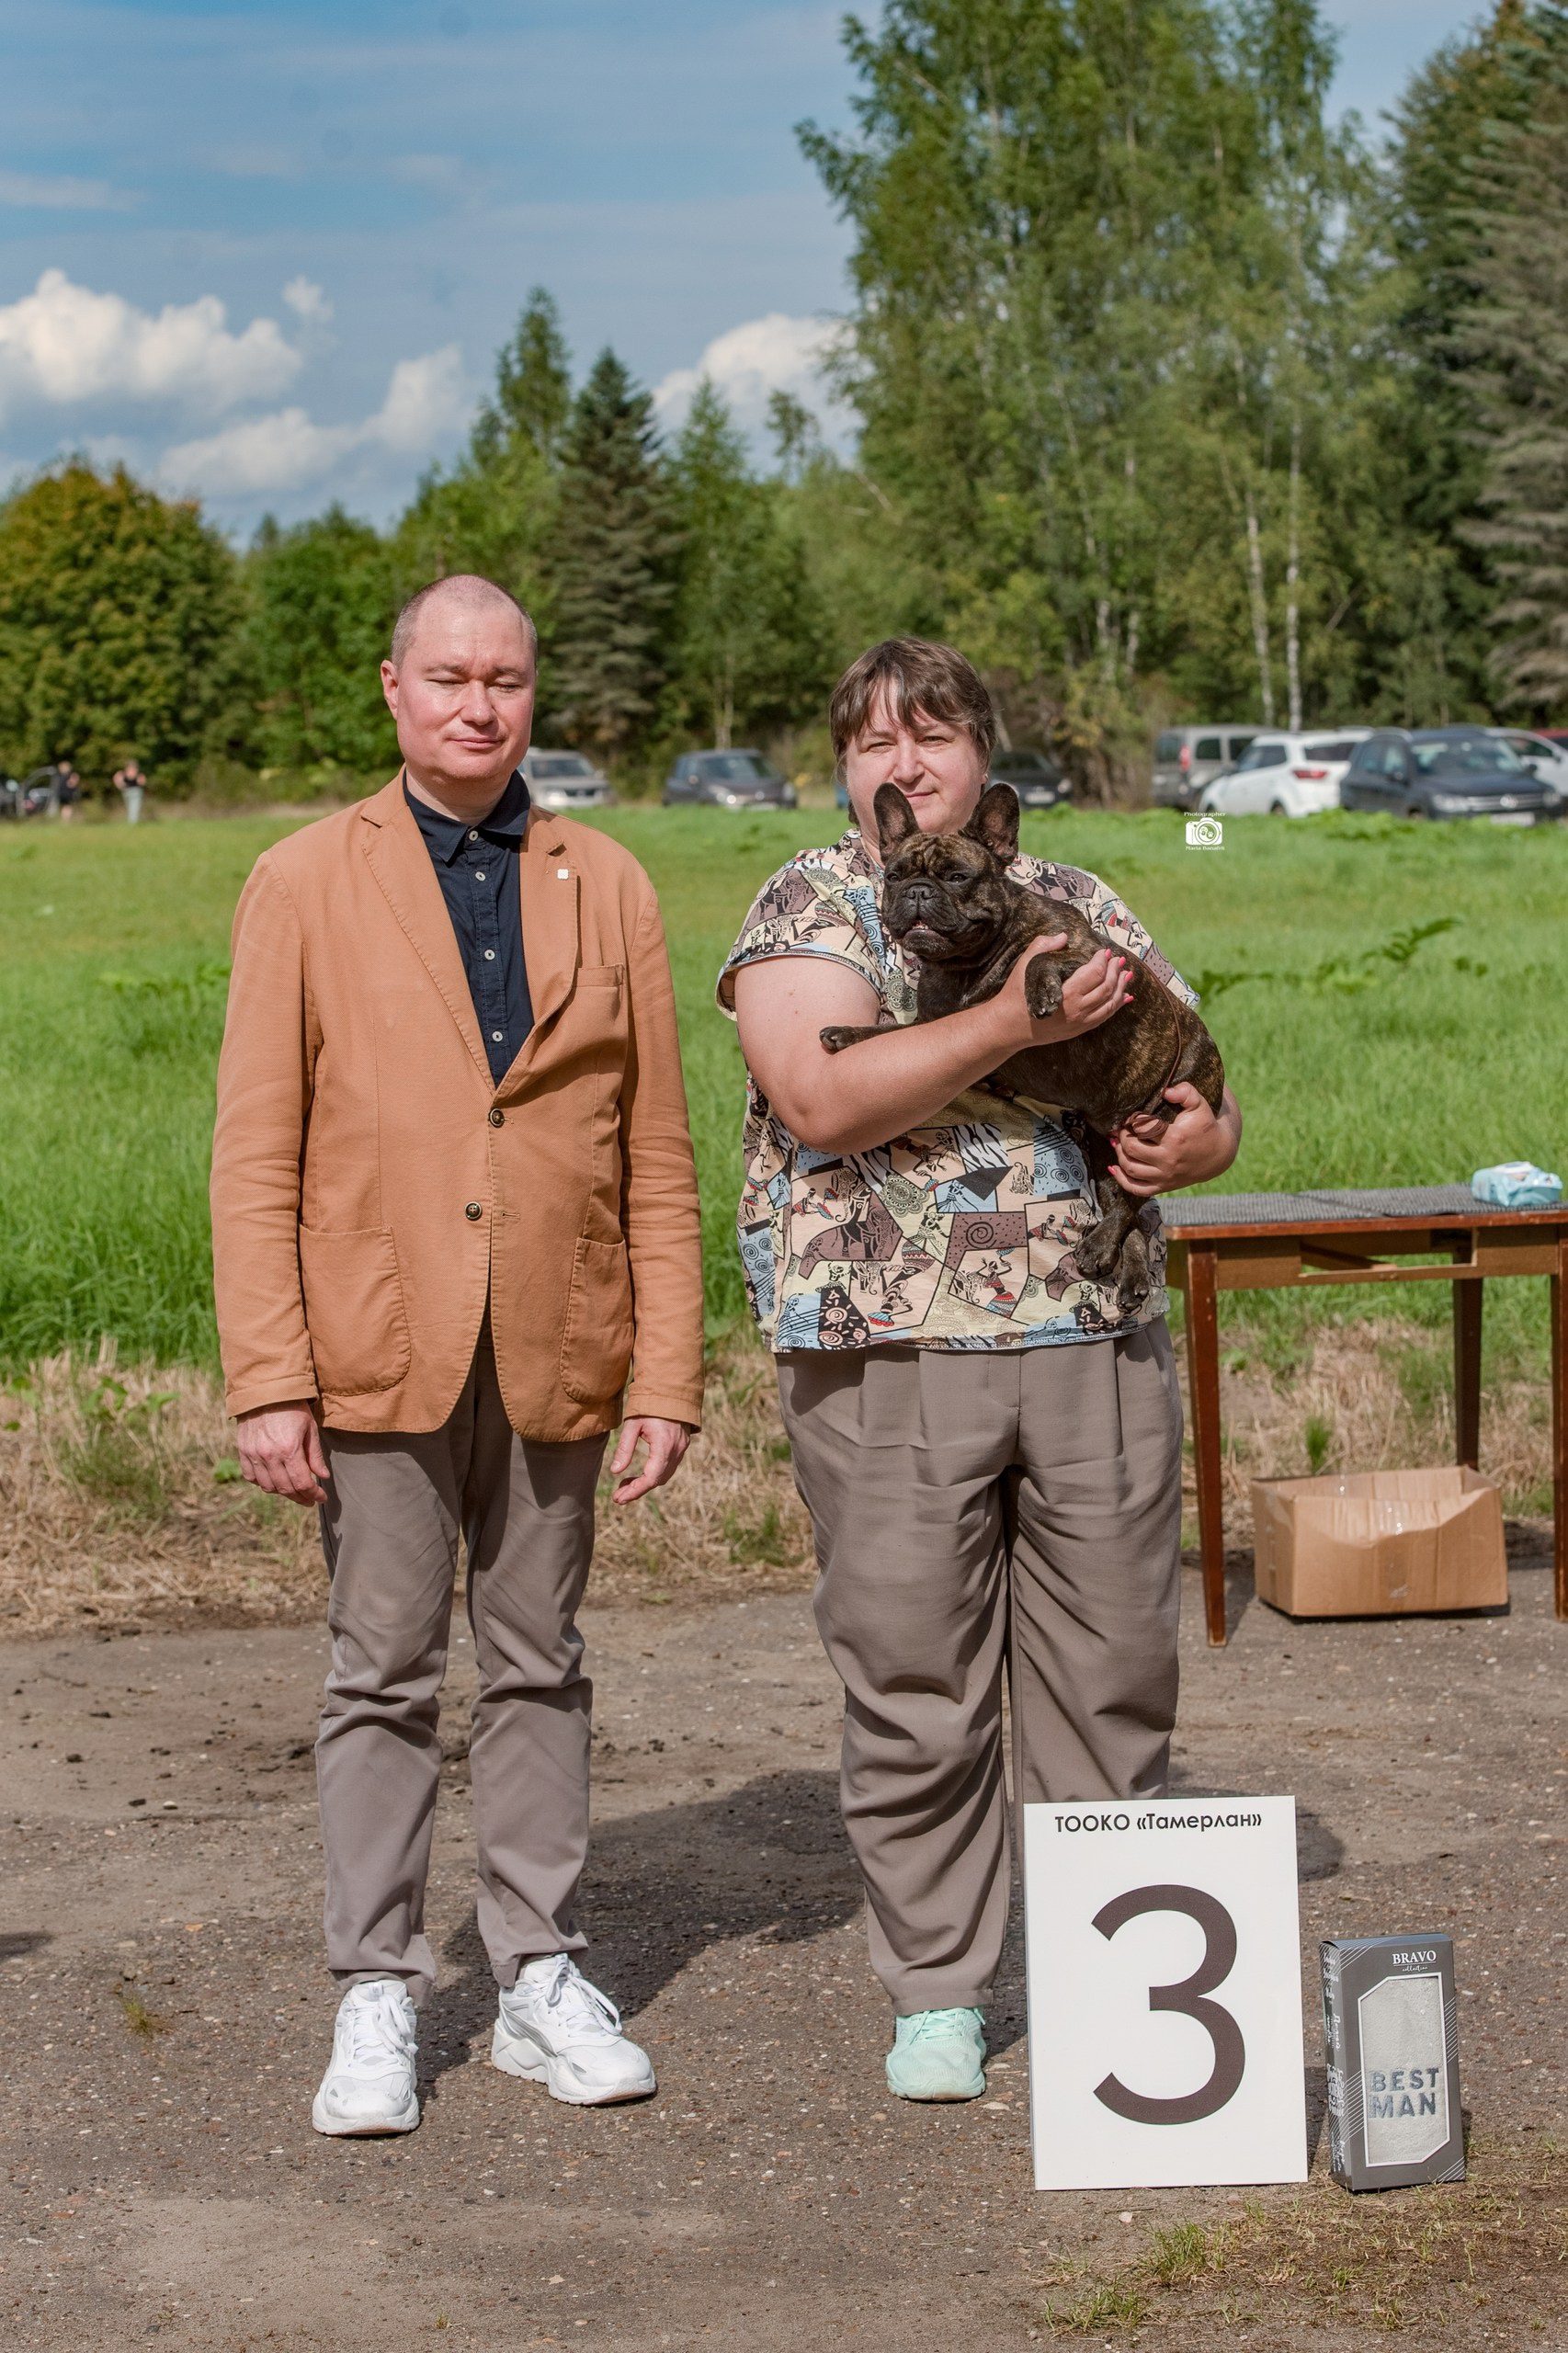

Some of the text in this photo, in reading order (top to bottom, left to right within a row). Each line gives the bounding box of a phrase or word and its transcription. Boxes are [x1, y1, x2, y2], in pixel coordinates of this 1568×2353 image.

[1054, 1813, 1262, 1833] ТООКО «Тамерлан»
[1392, 1949, 1437, 1965] BRAVO
[1091, 1883, 1245, 2125] 3
[1370, 2067, 1439, 2092] BEST
[1368, 2092, 1436, 2119] MAN
